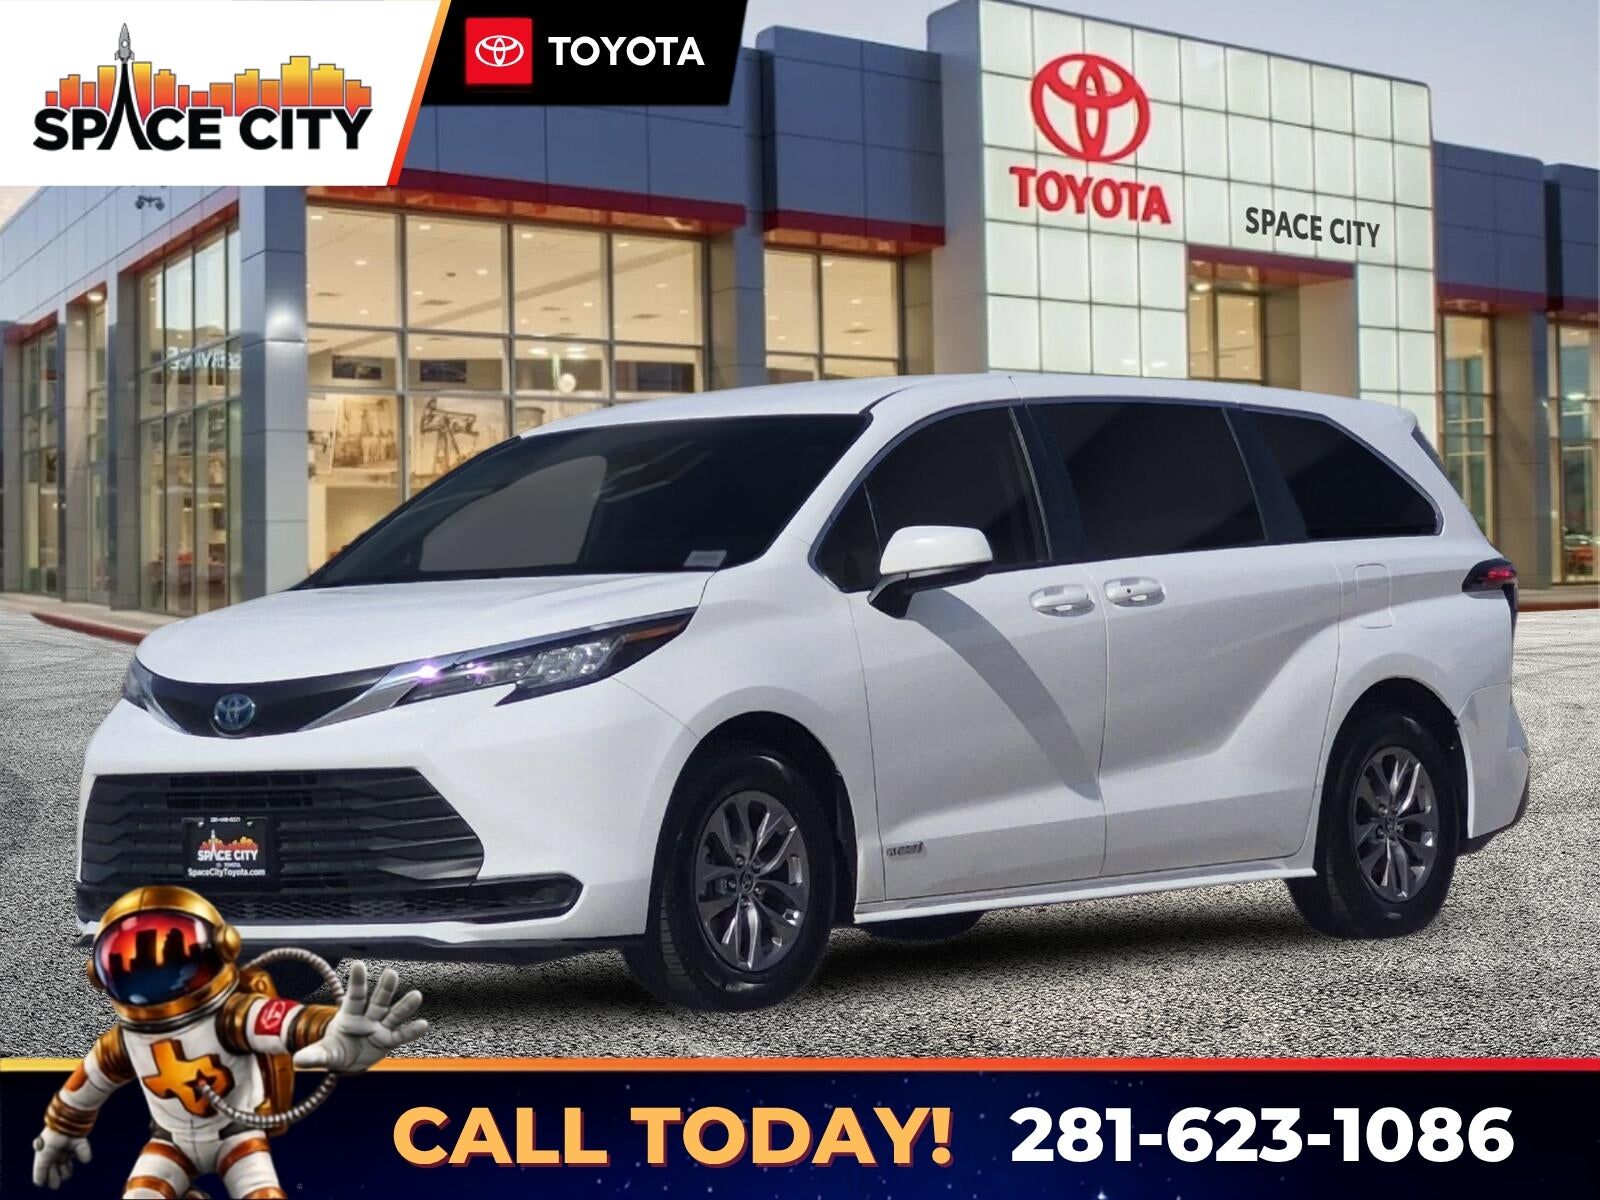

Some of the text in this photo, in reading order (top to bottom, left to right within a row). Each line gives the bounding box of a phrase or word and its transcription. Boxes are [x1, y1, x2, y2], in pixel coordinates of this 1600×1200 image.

[1009, 166, 1171, 224] TOYOTA
[1245, 206, 1381, 248] SPACE CITY
[197, 848, 258, 861] SPACE CITY
[187, 867, 266, 877] SpaceCityToyota.com
